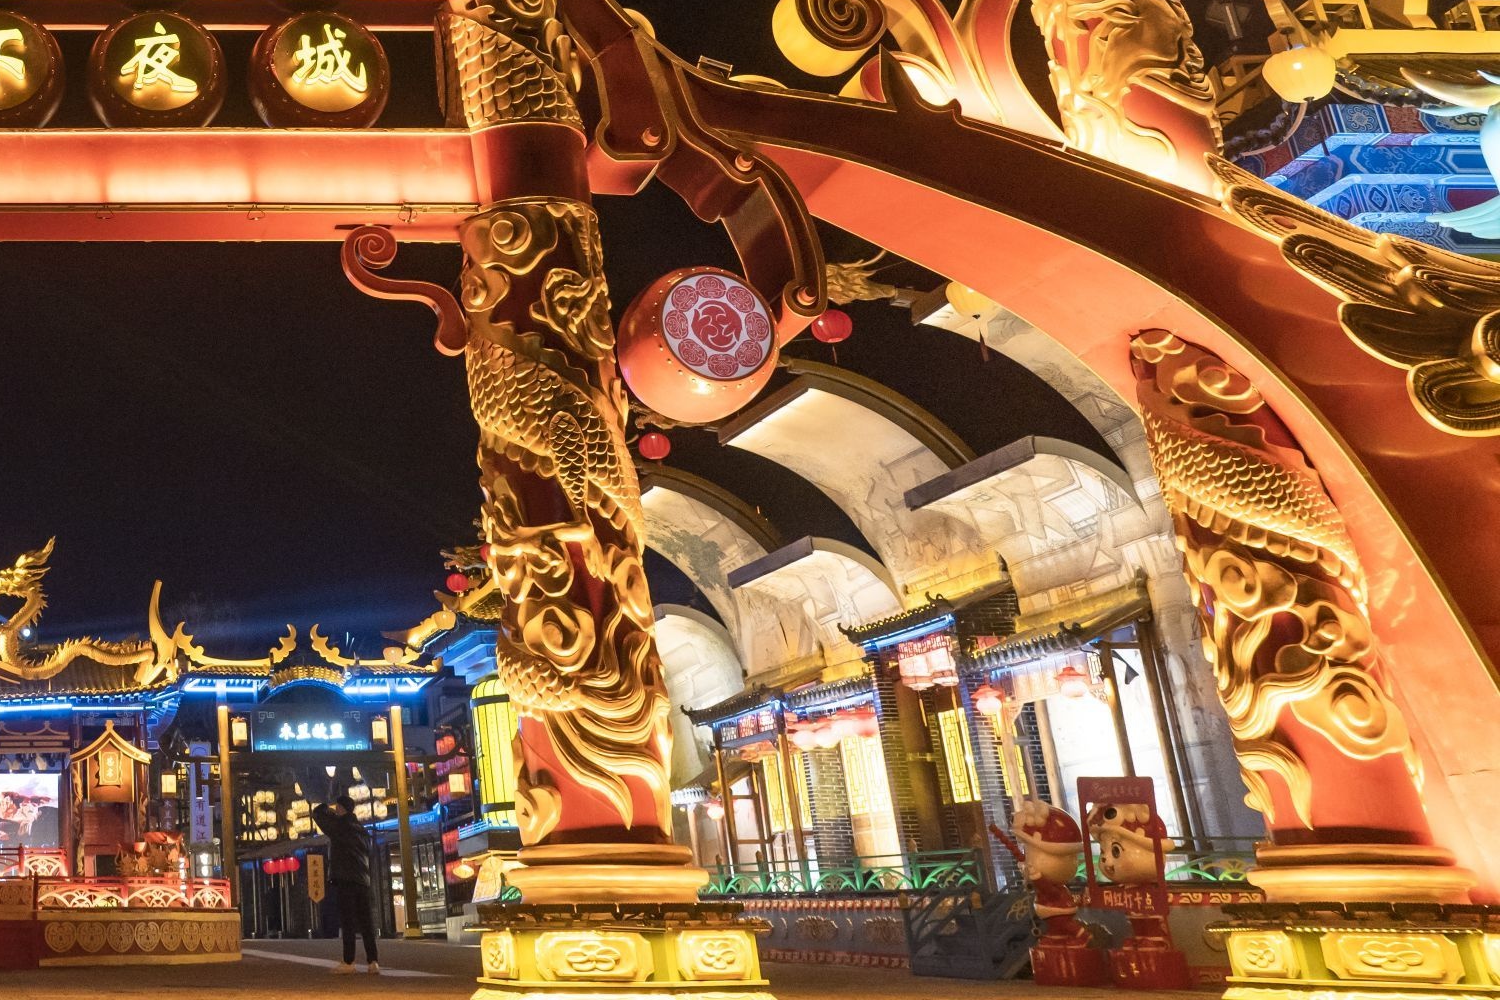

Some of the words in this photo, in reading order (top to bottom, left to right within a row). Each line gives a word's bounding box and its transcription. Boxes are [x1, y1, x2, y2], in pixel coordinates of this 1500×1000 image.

[278, 722, 346, 741] 木兰故里
[1103, 890, 1155, 910] 网红打卡点
